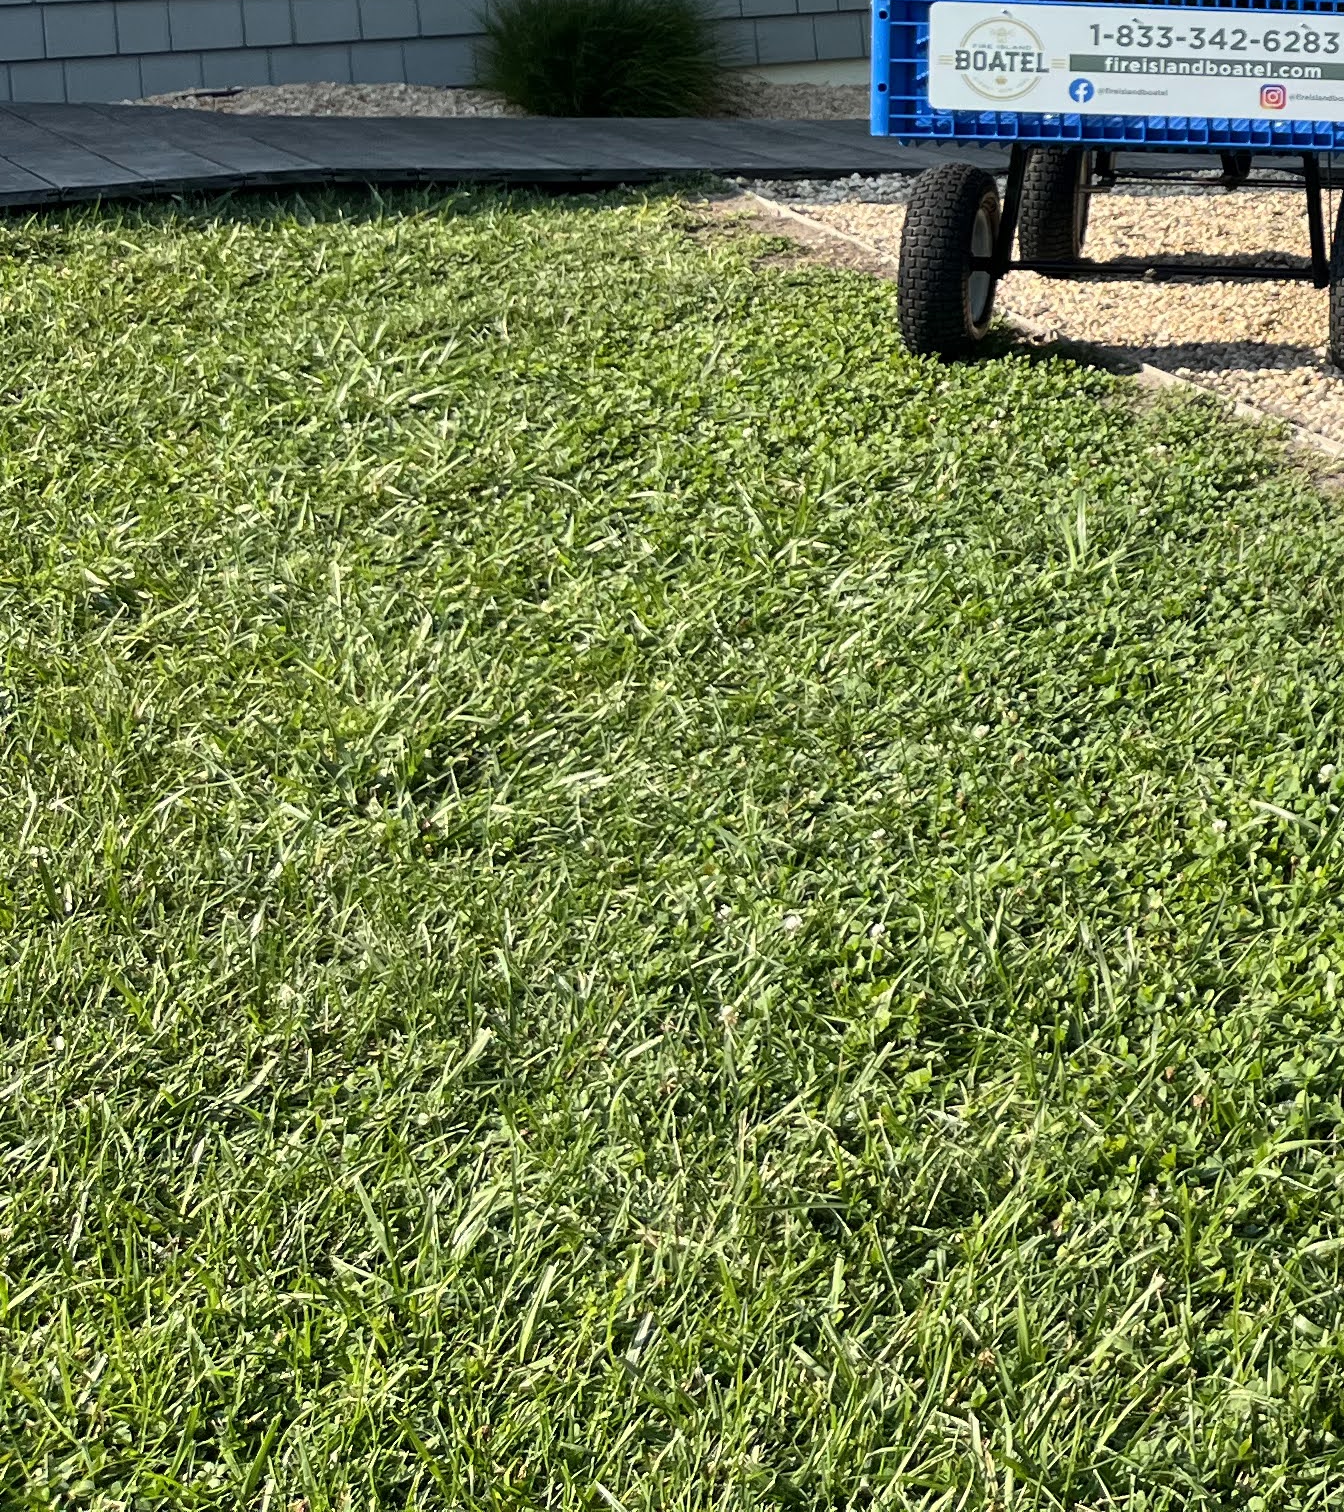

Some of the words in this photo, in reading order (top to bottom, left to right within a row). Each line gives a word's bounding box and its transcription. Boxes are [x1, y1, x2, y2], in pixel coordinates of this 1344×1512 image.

[1089, 23, 1340, 54] 1-833-342-6283
[955, 49, 1050, 73] BOATEL
[1104, 57, 1321, 78] fireislandboatel.com
